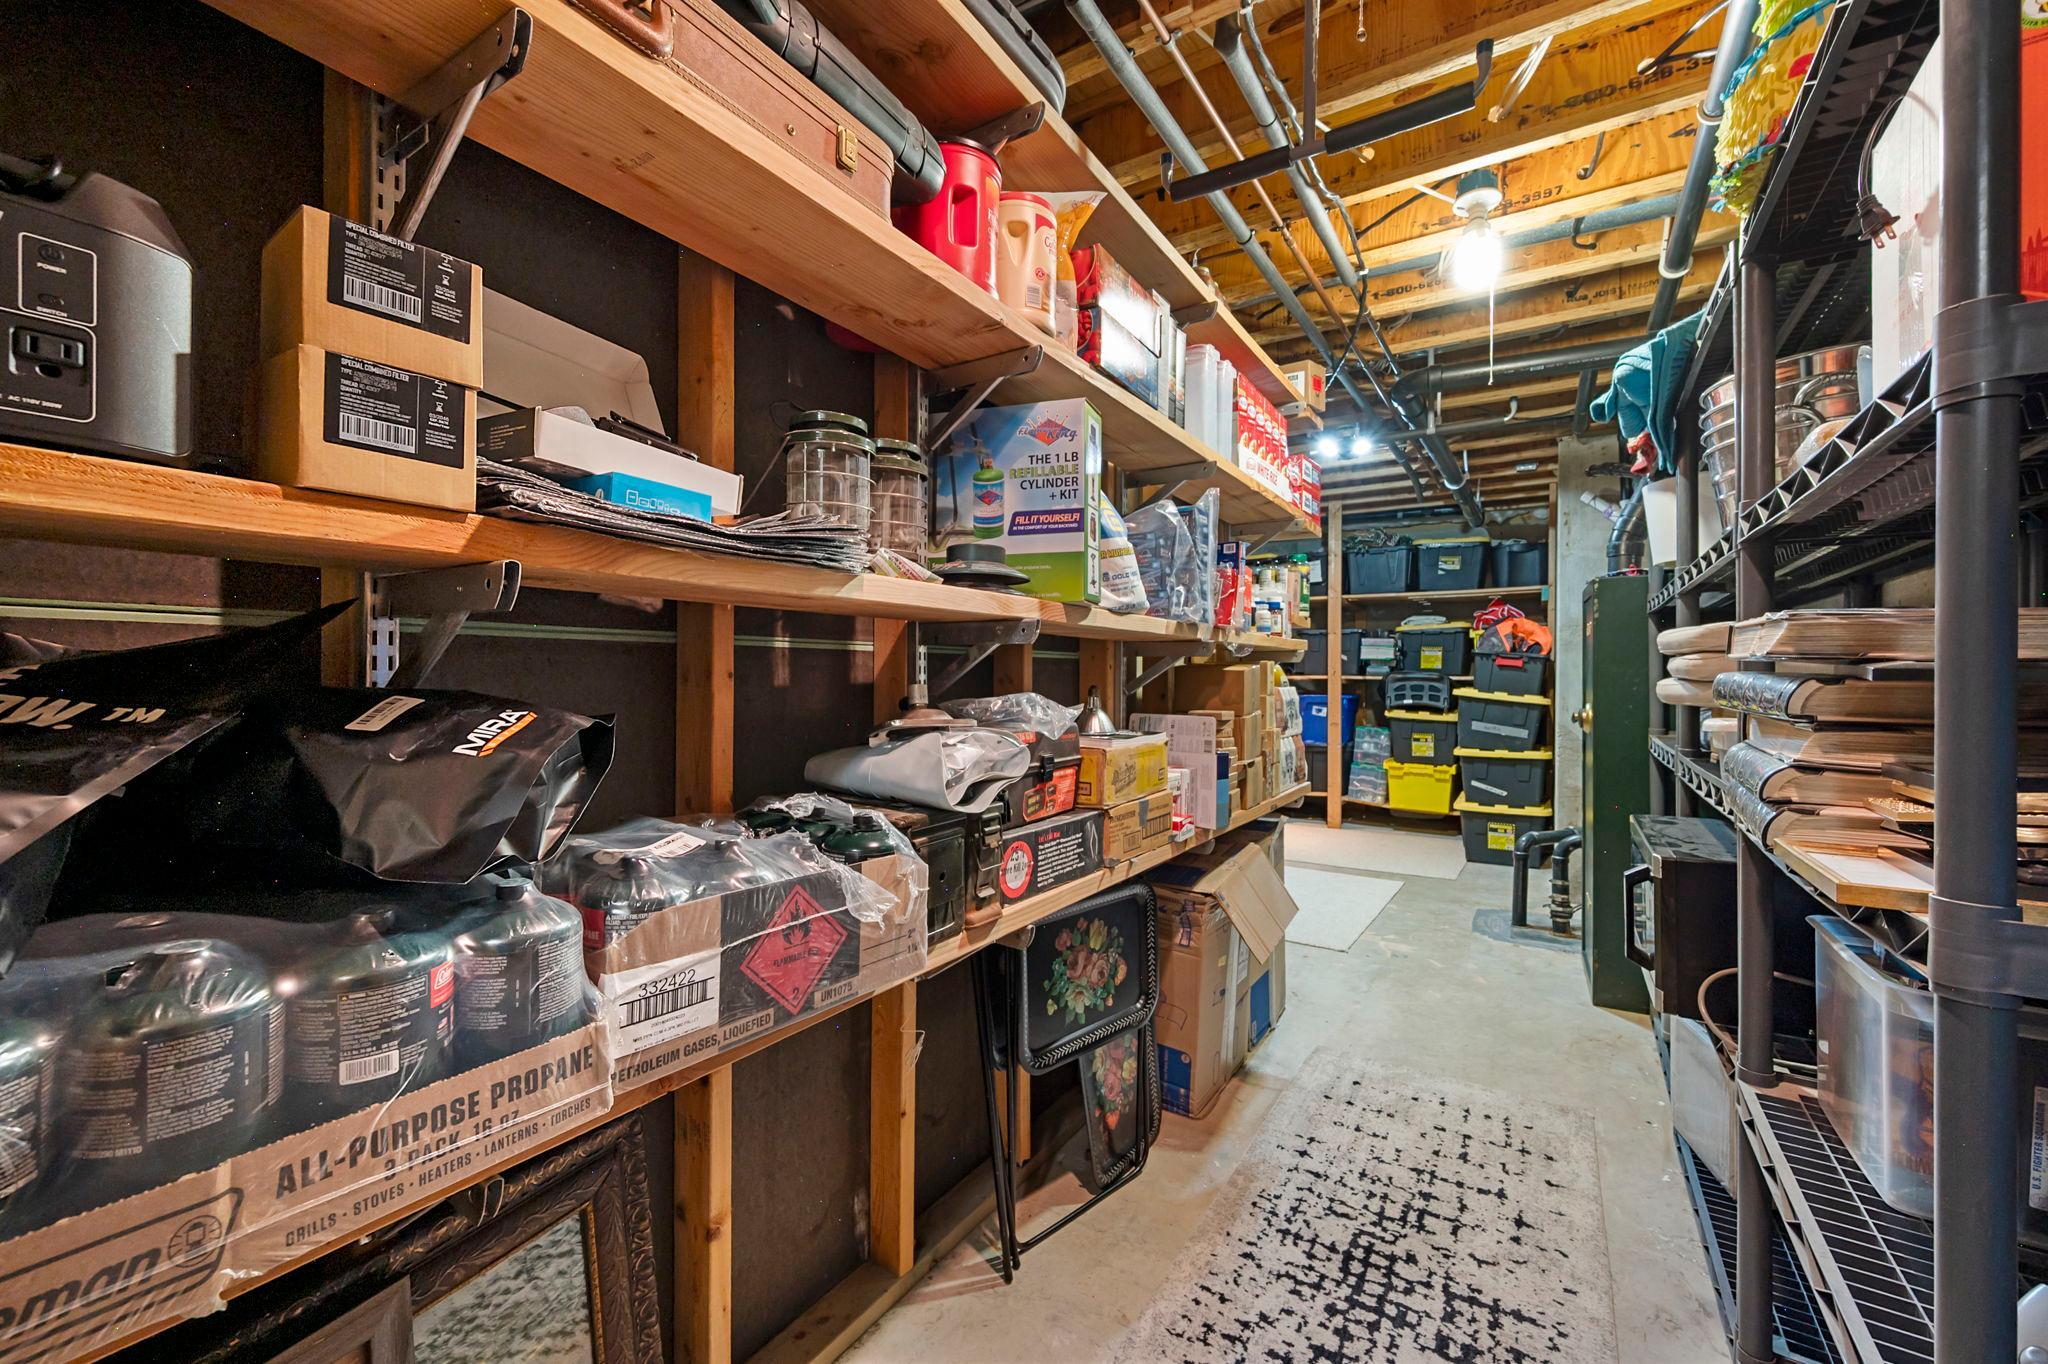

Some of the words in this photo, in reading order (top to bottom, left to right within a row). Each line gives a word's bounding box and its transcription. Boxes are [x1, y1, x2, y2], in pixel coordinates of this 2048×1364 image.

[397, 239, 415, 252] FILTER
[36, 262, 67, 274] POWER
[36, 306, 67, 318] SWITCH
[340, 358, 364, 370] SPECIAL
[364, 364, 391, 376] COMBINED
[392, 371, 409, 382] FILTER
[1028, 453, 1051, 465] THE
[1055, 453, 1060, 463] 1
[1064, 451, 1079, 463] LB
[1009, 464, 1079, 479] REFILLABLE
[1020, 476, 1079, 490] CYLINDER
[1060, 488, 1079, 500] KIT
[1015, 515, 1030, 525] FILL
[1031, 514, 1039, 523] IT
[1039, 512, 1080, 523] YOURSELF!
[638, 968, 697, 998] 332422
[792, 987, 800, 1000] 2
[820, 983, 853, 1001] UN1075
[611, 1049, 681, 1084] PETROLEUM
[684, 1034, 720, 1058] GASES,
[723, 1013, 771, 1041] LIQUEFIED
[276, 1090, 480, 1199] ALL-PURPOSE
[491, 1044, 593, 1109] PROPANE
[384, 1158, 396, 1181] 3
[408, 1130, 461, 1171] PACK
[473, 1117, 492, 1142] 16
[2032, 1141, 2043, 1172] FIGHTER
[286, 1213, 337, 1247] GRILLS
[353, 1183, 405, 1217] STOVES
[419, 1153, 471, 1187] HEATERS
[484, 1122, 539, 1157] LANTERNS
[551, 1097, 592, 1127] TORCHES
